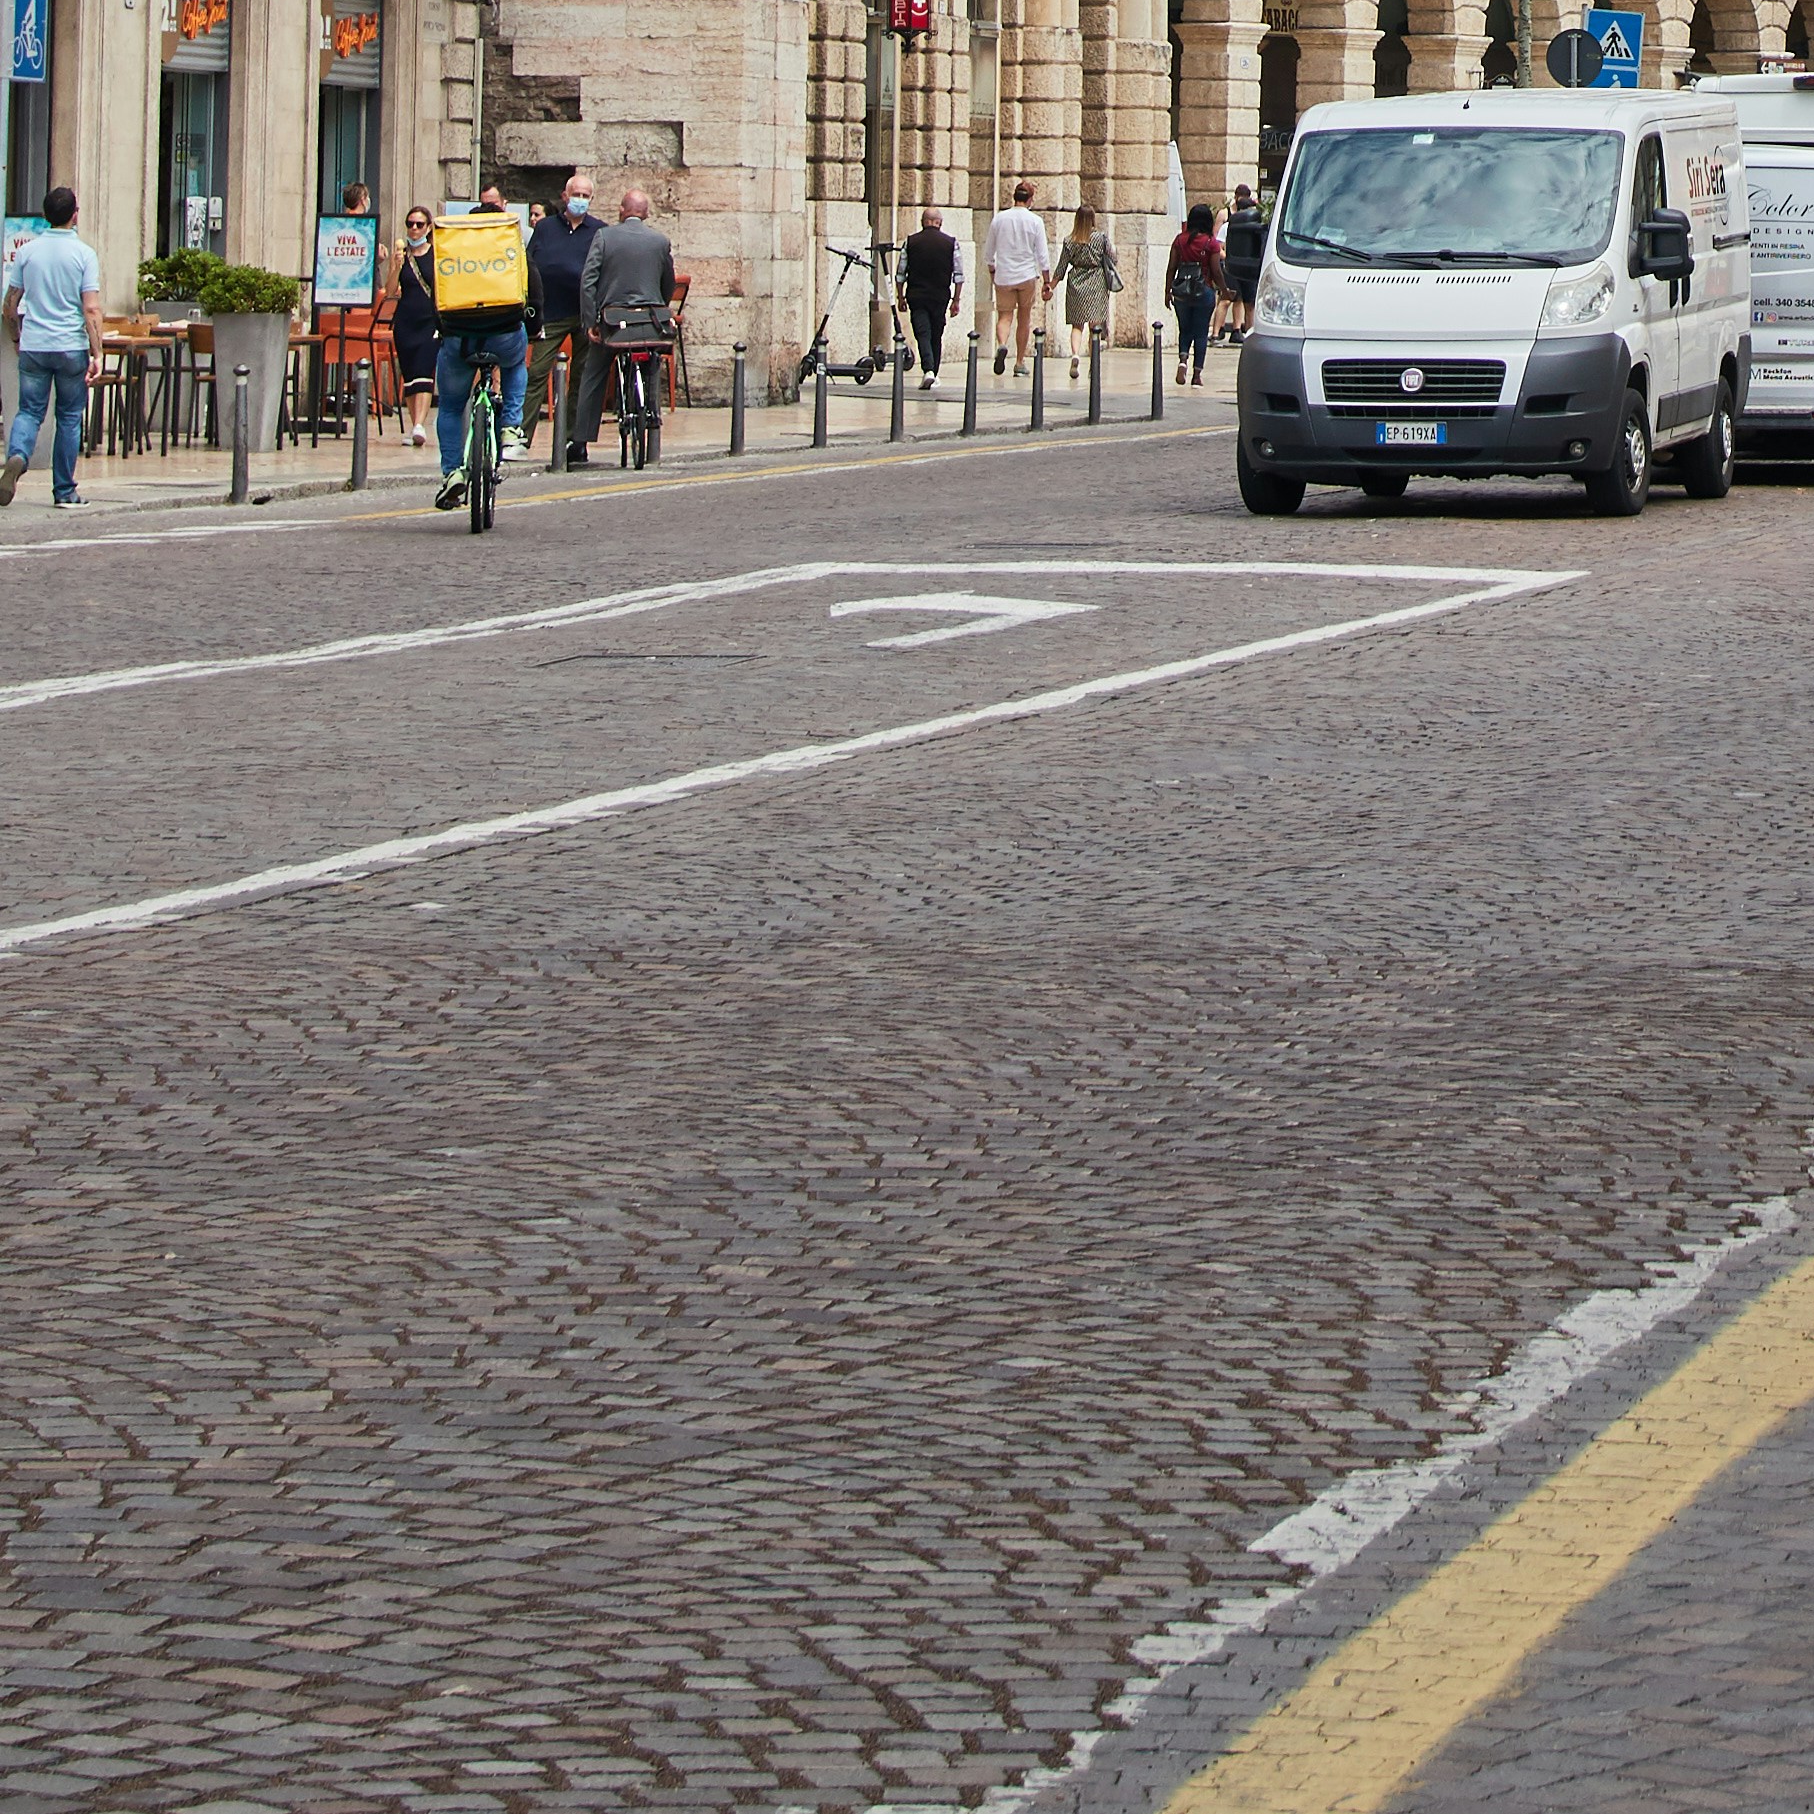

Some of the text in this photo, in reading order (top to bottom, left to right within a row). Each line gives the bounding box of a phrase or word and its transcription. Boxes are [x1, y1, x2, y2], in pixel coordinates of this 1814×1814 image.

[1686, 155, 1726, 199] Siri Sera
[1753, 227, 1814, 235] DESIGN
[337, 234, 357, 245] VIVA
[439, 256, 507, 277] Glovo
[1753, 298, 1773, 307] cell.
[1775, 298, 1793, 307] 340
